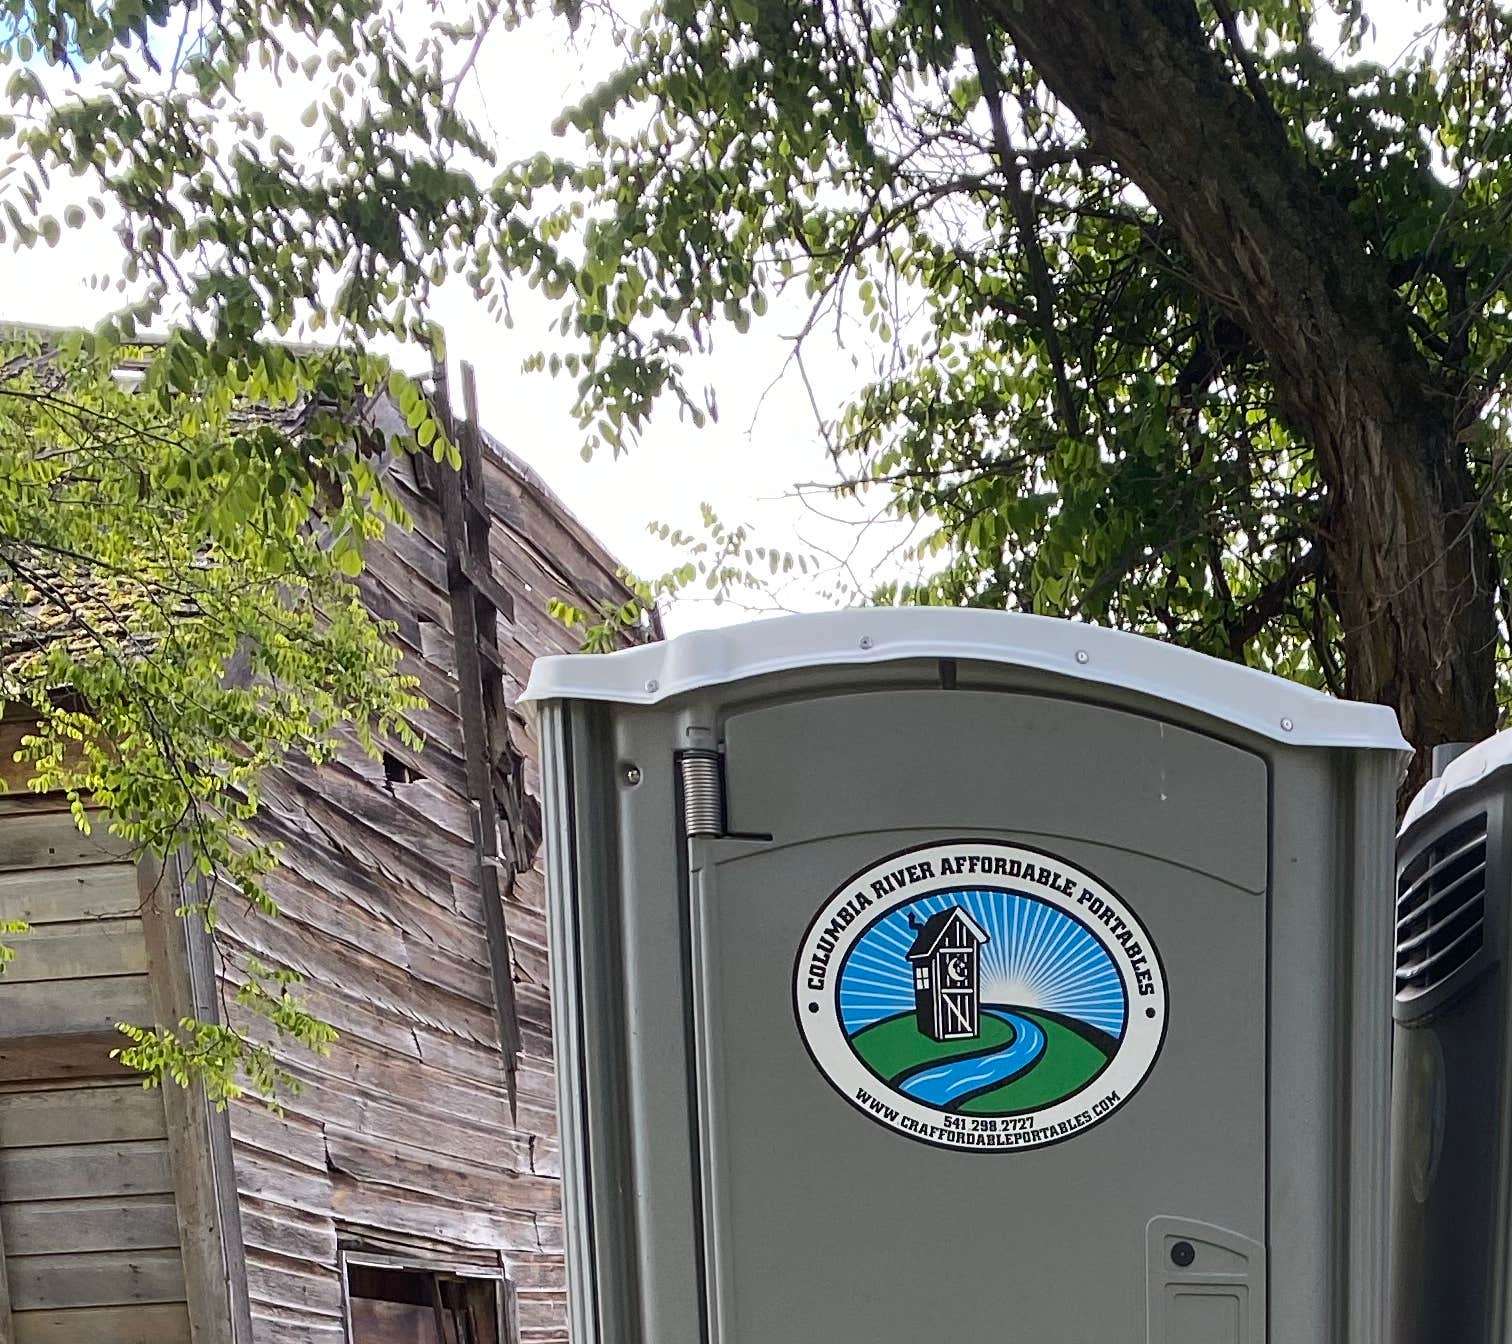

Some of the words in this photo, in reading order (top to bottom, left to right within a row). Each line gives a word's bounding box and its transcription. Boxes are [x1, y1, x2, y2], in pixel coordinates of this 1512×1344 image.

[808, 892, 873, 991] COLUMBIA
[871, 862, 935, 900] RIVER
[940, 856, 1077, 898] AFFORDABLE
[1078, 888, 1155, 996] PORTABLES
